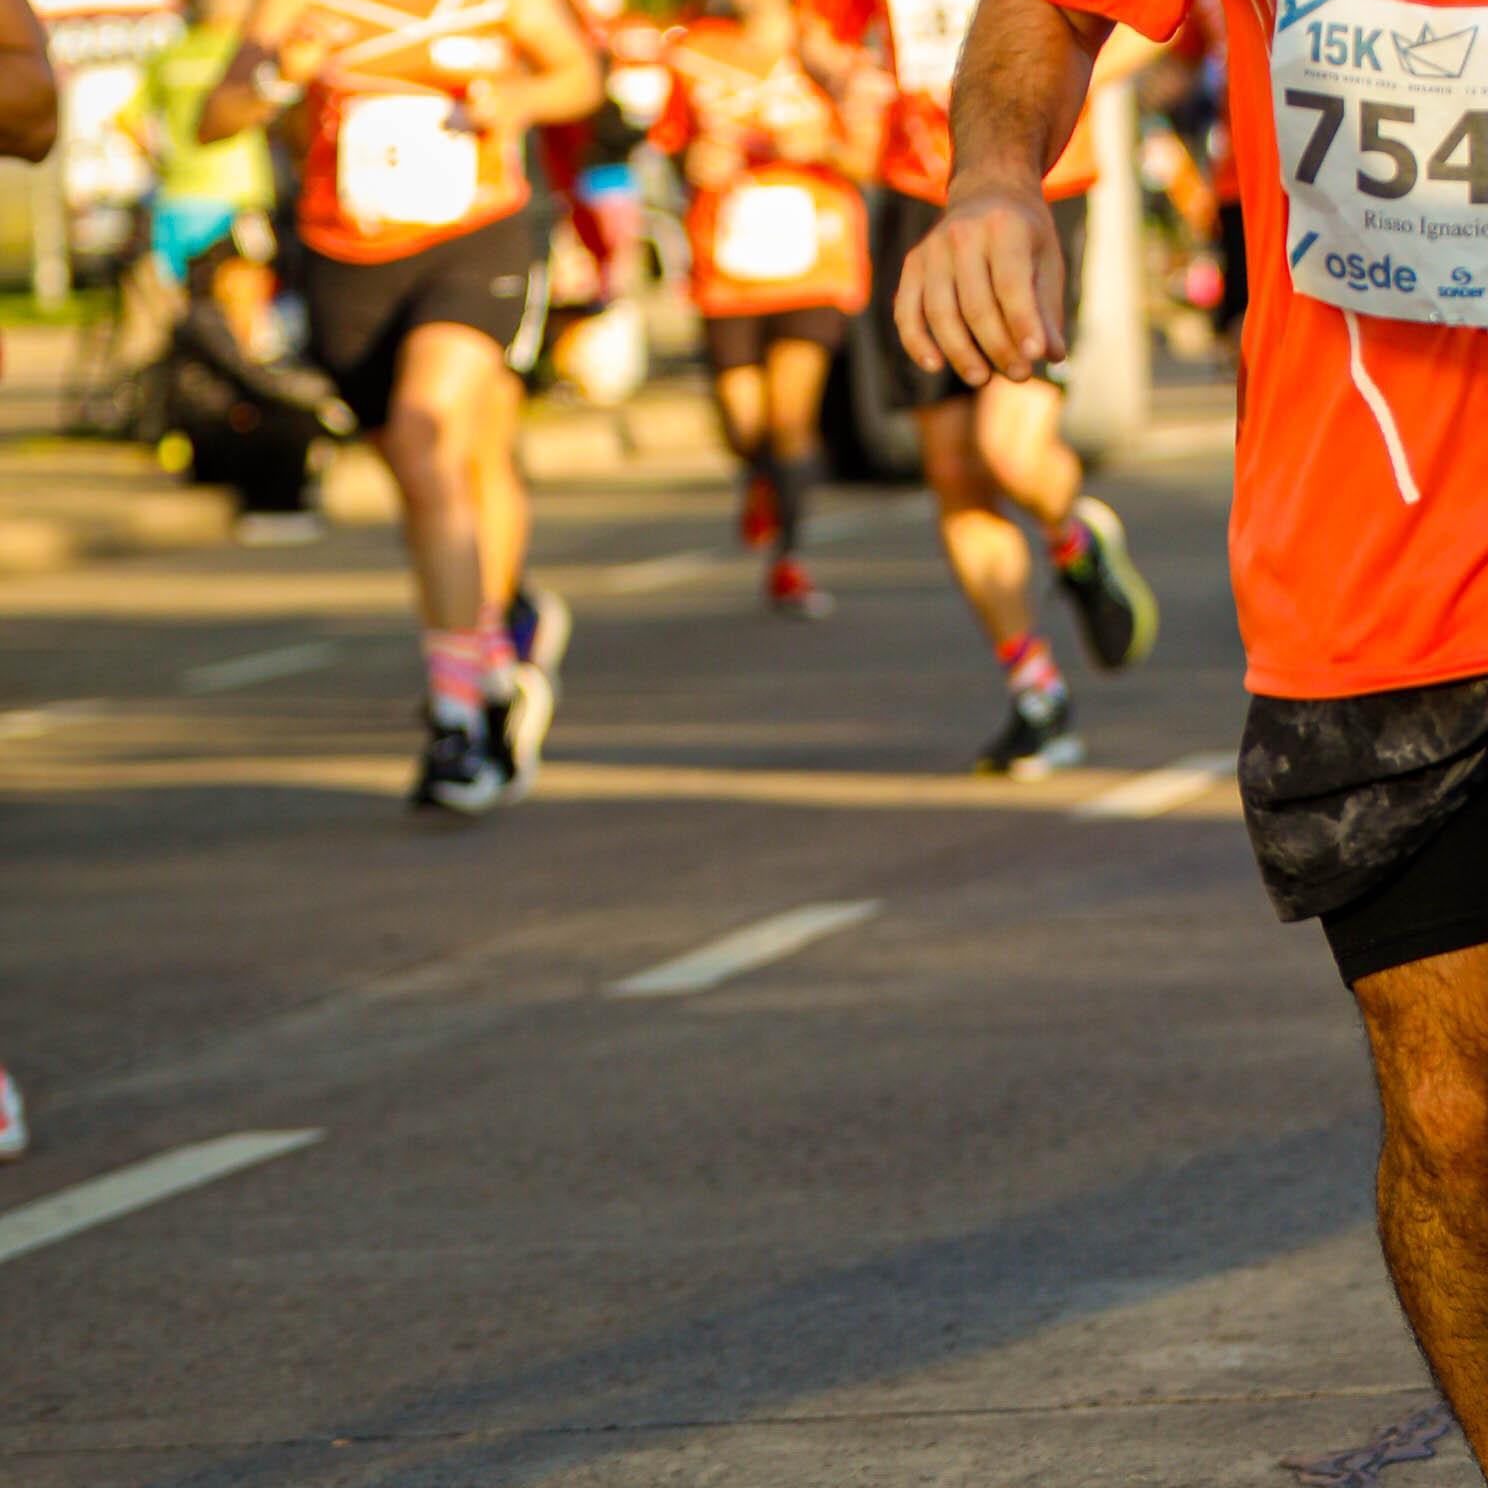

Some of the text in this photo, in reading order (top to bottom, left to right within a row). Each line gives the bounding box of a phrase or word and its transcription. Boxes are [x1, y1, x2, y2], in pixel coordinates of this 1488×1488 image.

[1305, 20, 1383, 72] 15K
[1363, 209, 1412, 234] Risso
[1325, 252, 1417, 293] osde
